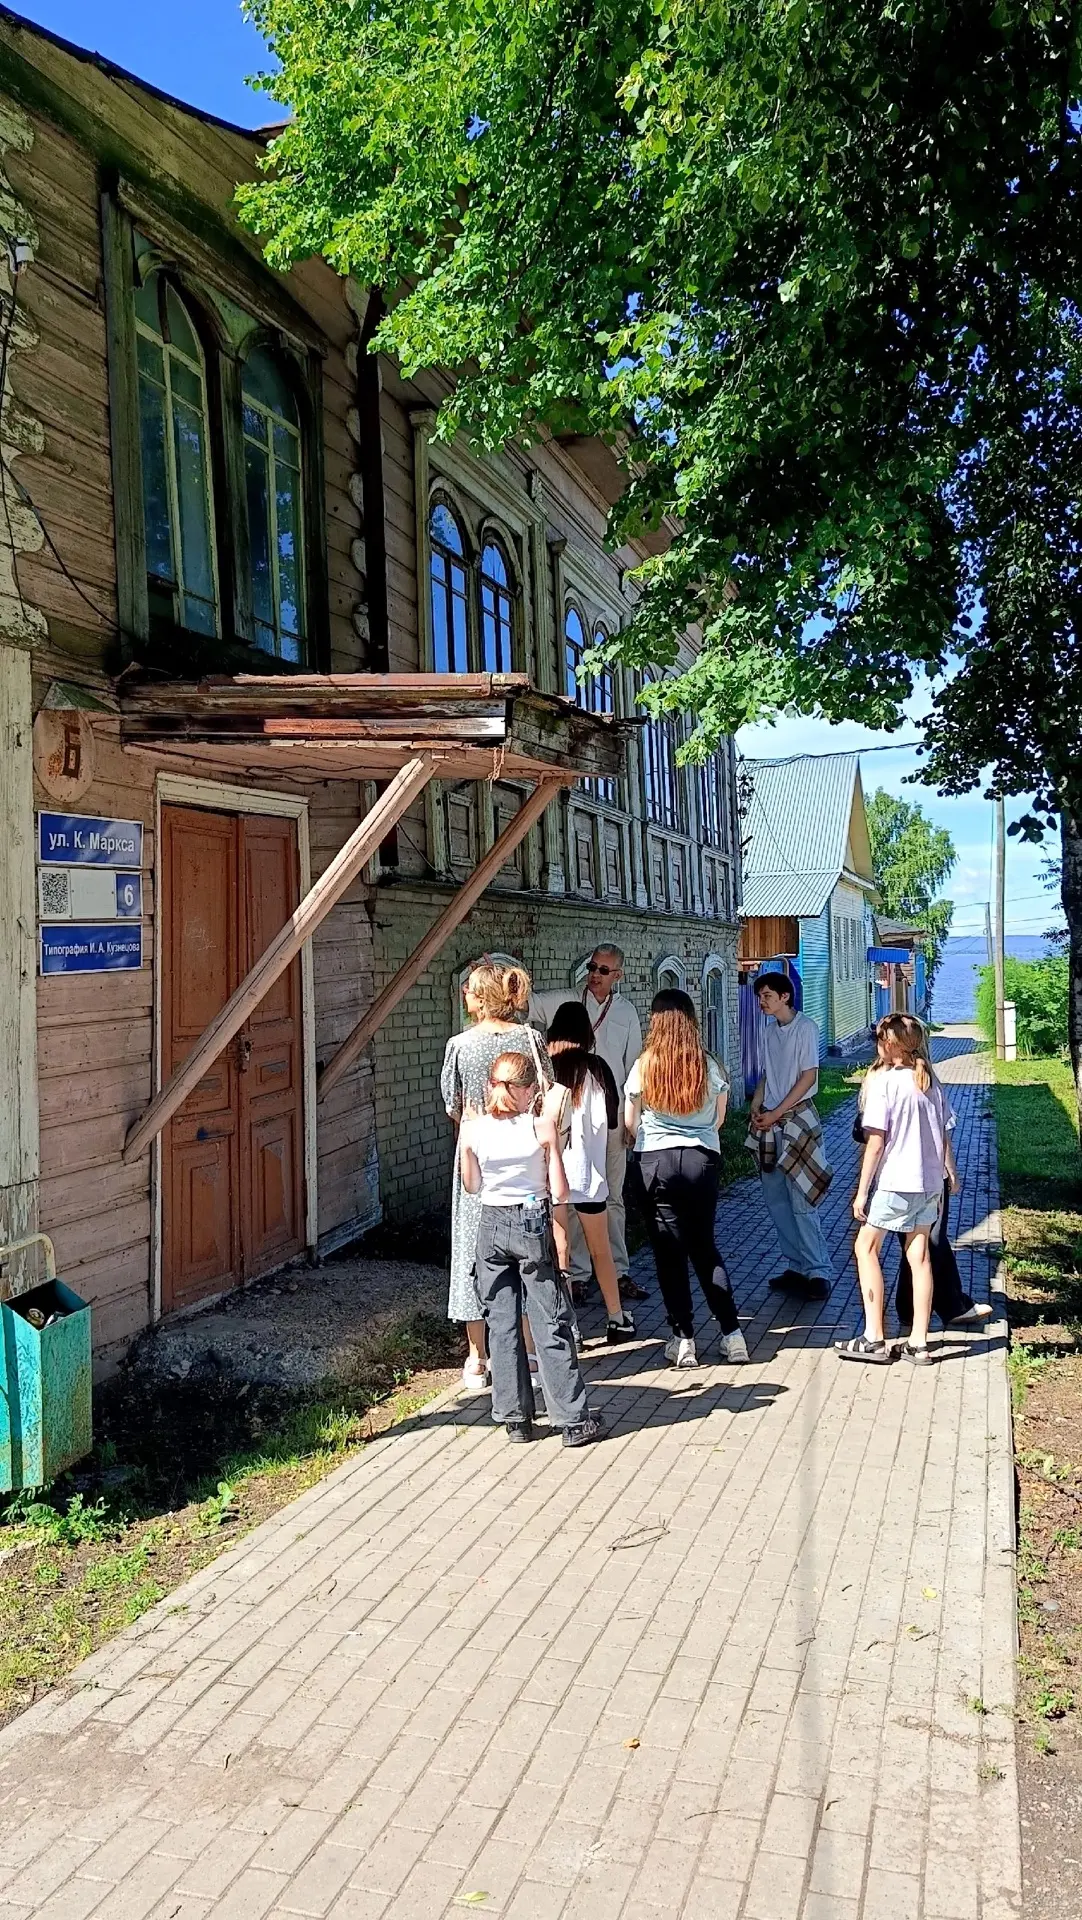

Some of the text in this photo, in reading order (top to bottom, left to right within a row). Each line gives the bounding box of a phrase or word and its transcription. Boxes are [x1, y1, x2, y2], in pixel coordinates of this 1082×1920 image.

[49, 830, 135, 855] ул. К. Маркса
[124, 884, 134, 907] 6
[43, 941, 140, 957] Типография И. А. Кузнецова
